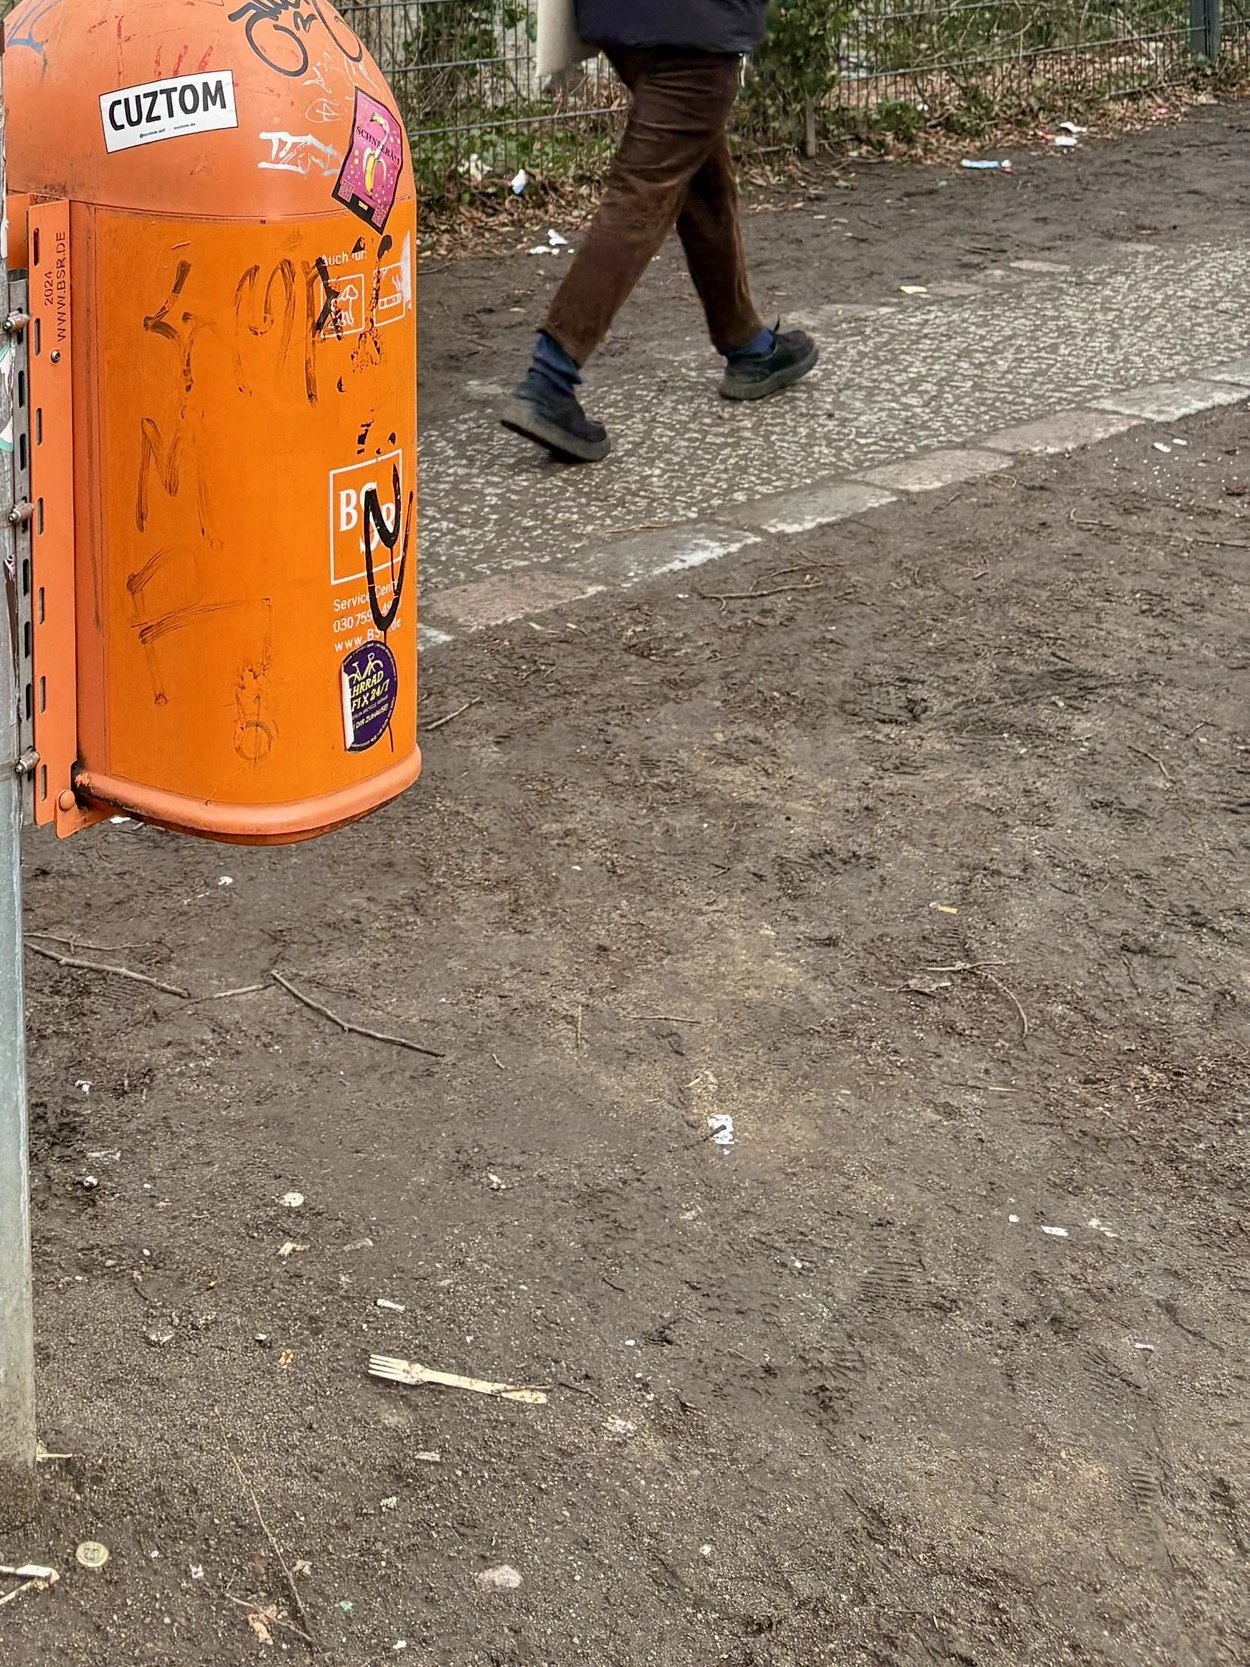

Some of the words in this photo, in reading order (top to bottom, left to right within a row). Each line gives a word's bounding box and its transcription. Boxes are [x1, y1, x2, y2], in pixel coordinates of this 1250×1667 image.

[108, 80, 227, 132] CUZTOM
[44, 270, 54, 306] 2024
[56, 231, 66, 343] WWW.BSR.DE
[333, 592, 371, 612] Service
[333, 616, 354, 633] 030
[352, 692, 369, 712] FIX
[370, 679, 390, 701] 24/7
